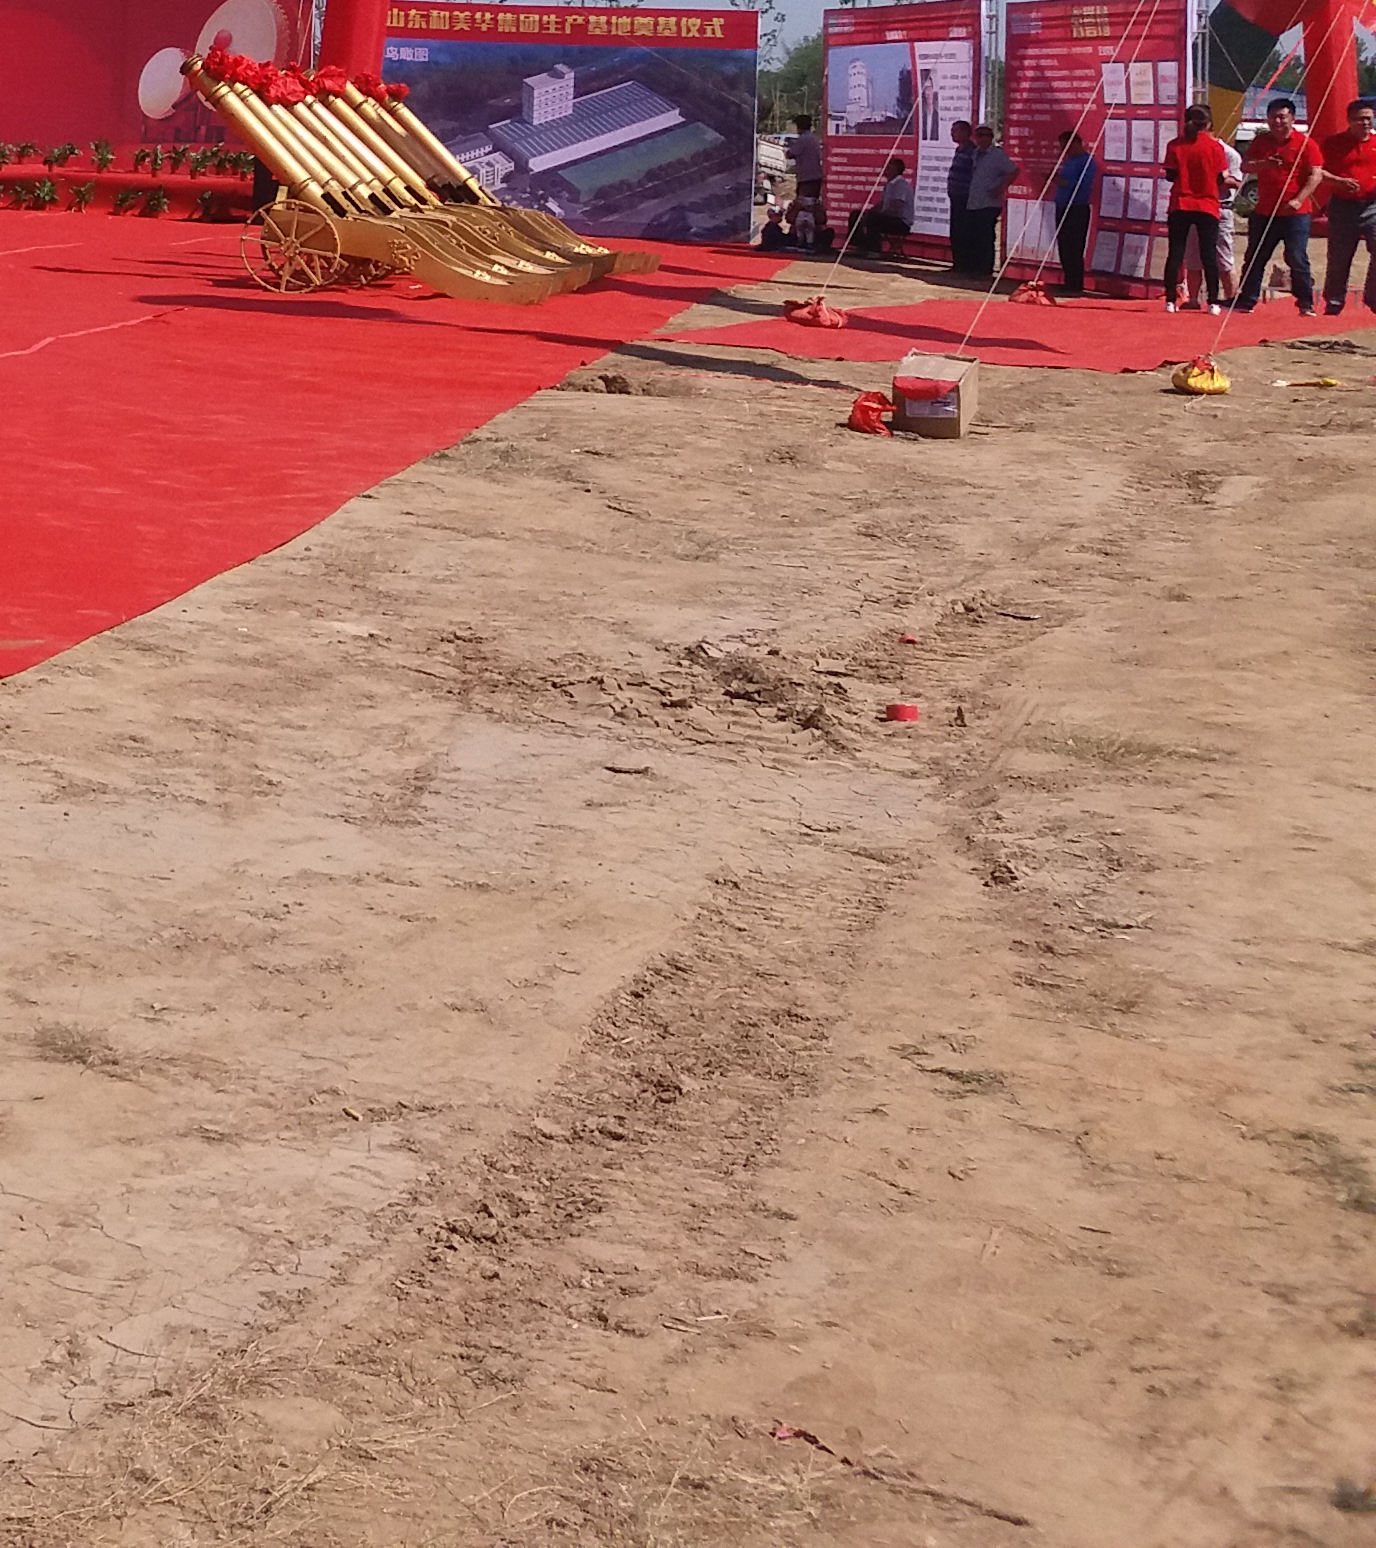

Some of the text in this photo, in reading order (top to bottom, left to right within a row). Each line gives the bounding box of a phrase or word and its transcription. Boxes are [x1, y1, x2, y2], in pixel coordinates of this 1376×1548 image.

[385, 7, 725, 39] 山东和美华集团生产基地奠基仪式
[384, 45, 430, 62] 鸟瞰图
